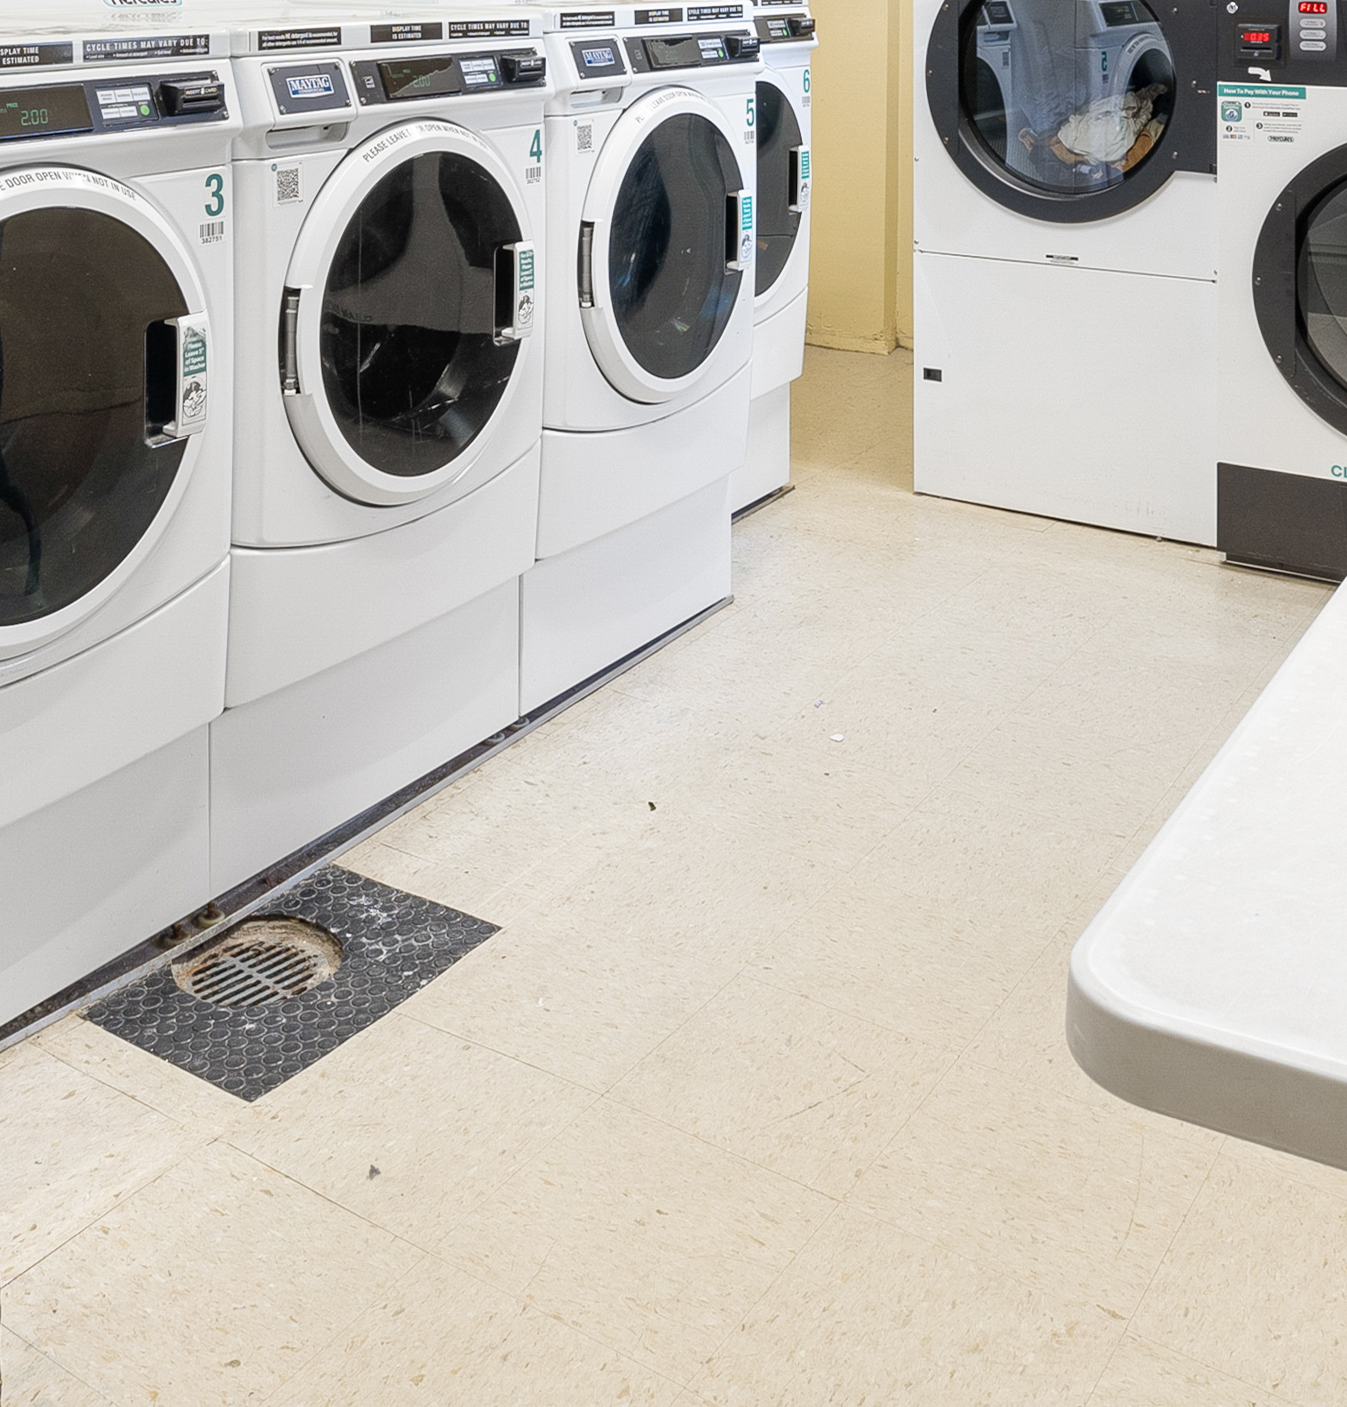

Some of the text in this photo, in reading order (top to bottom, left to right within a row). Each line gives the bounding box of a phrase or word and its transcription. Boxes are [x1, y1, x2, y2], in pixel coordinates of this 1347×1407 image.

[1299, 2, 1326, 13] FILL
[23, 46, 39, 55] TIME
[86, 37, 208, 52] CYCLE TIMES MAY VARY DUE TO:
[2, 55, 40, 65] ESTIMATED
[290, 76, 331, 91] MAYTAG
[803, 69, 810, 93] 6
[20, 109, 49, 126] 2.00
[746, 98, 754, 127] 5
[363, 132, 408, 163] PLEASE LEAVE
[529, 129, 542, 163] 4
[5, 170, 63, 189] DOOR OPEN
[205, 173, 225, 217] 3
